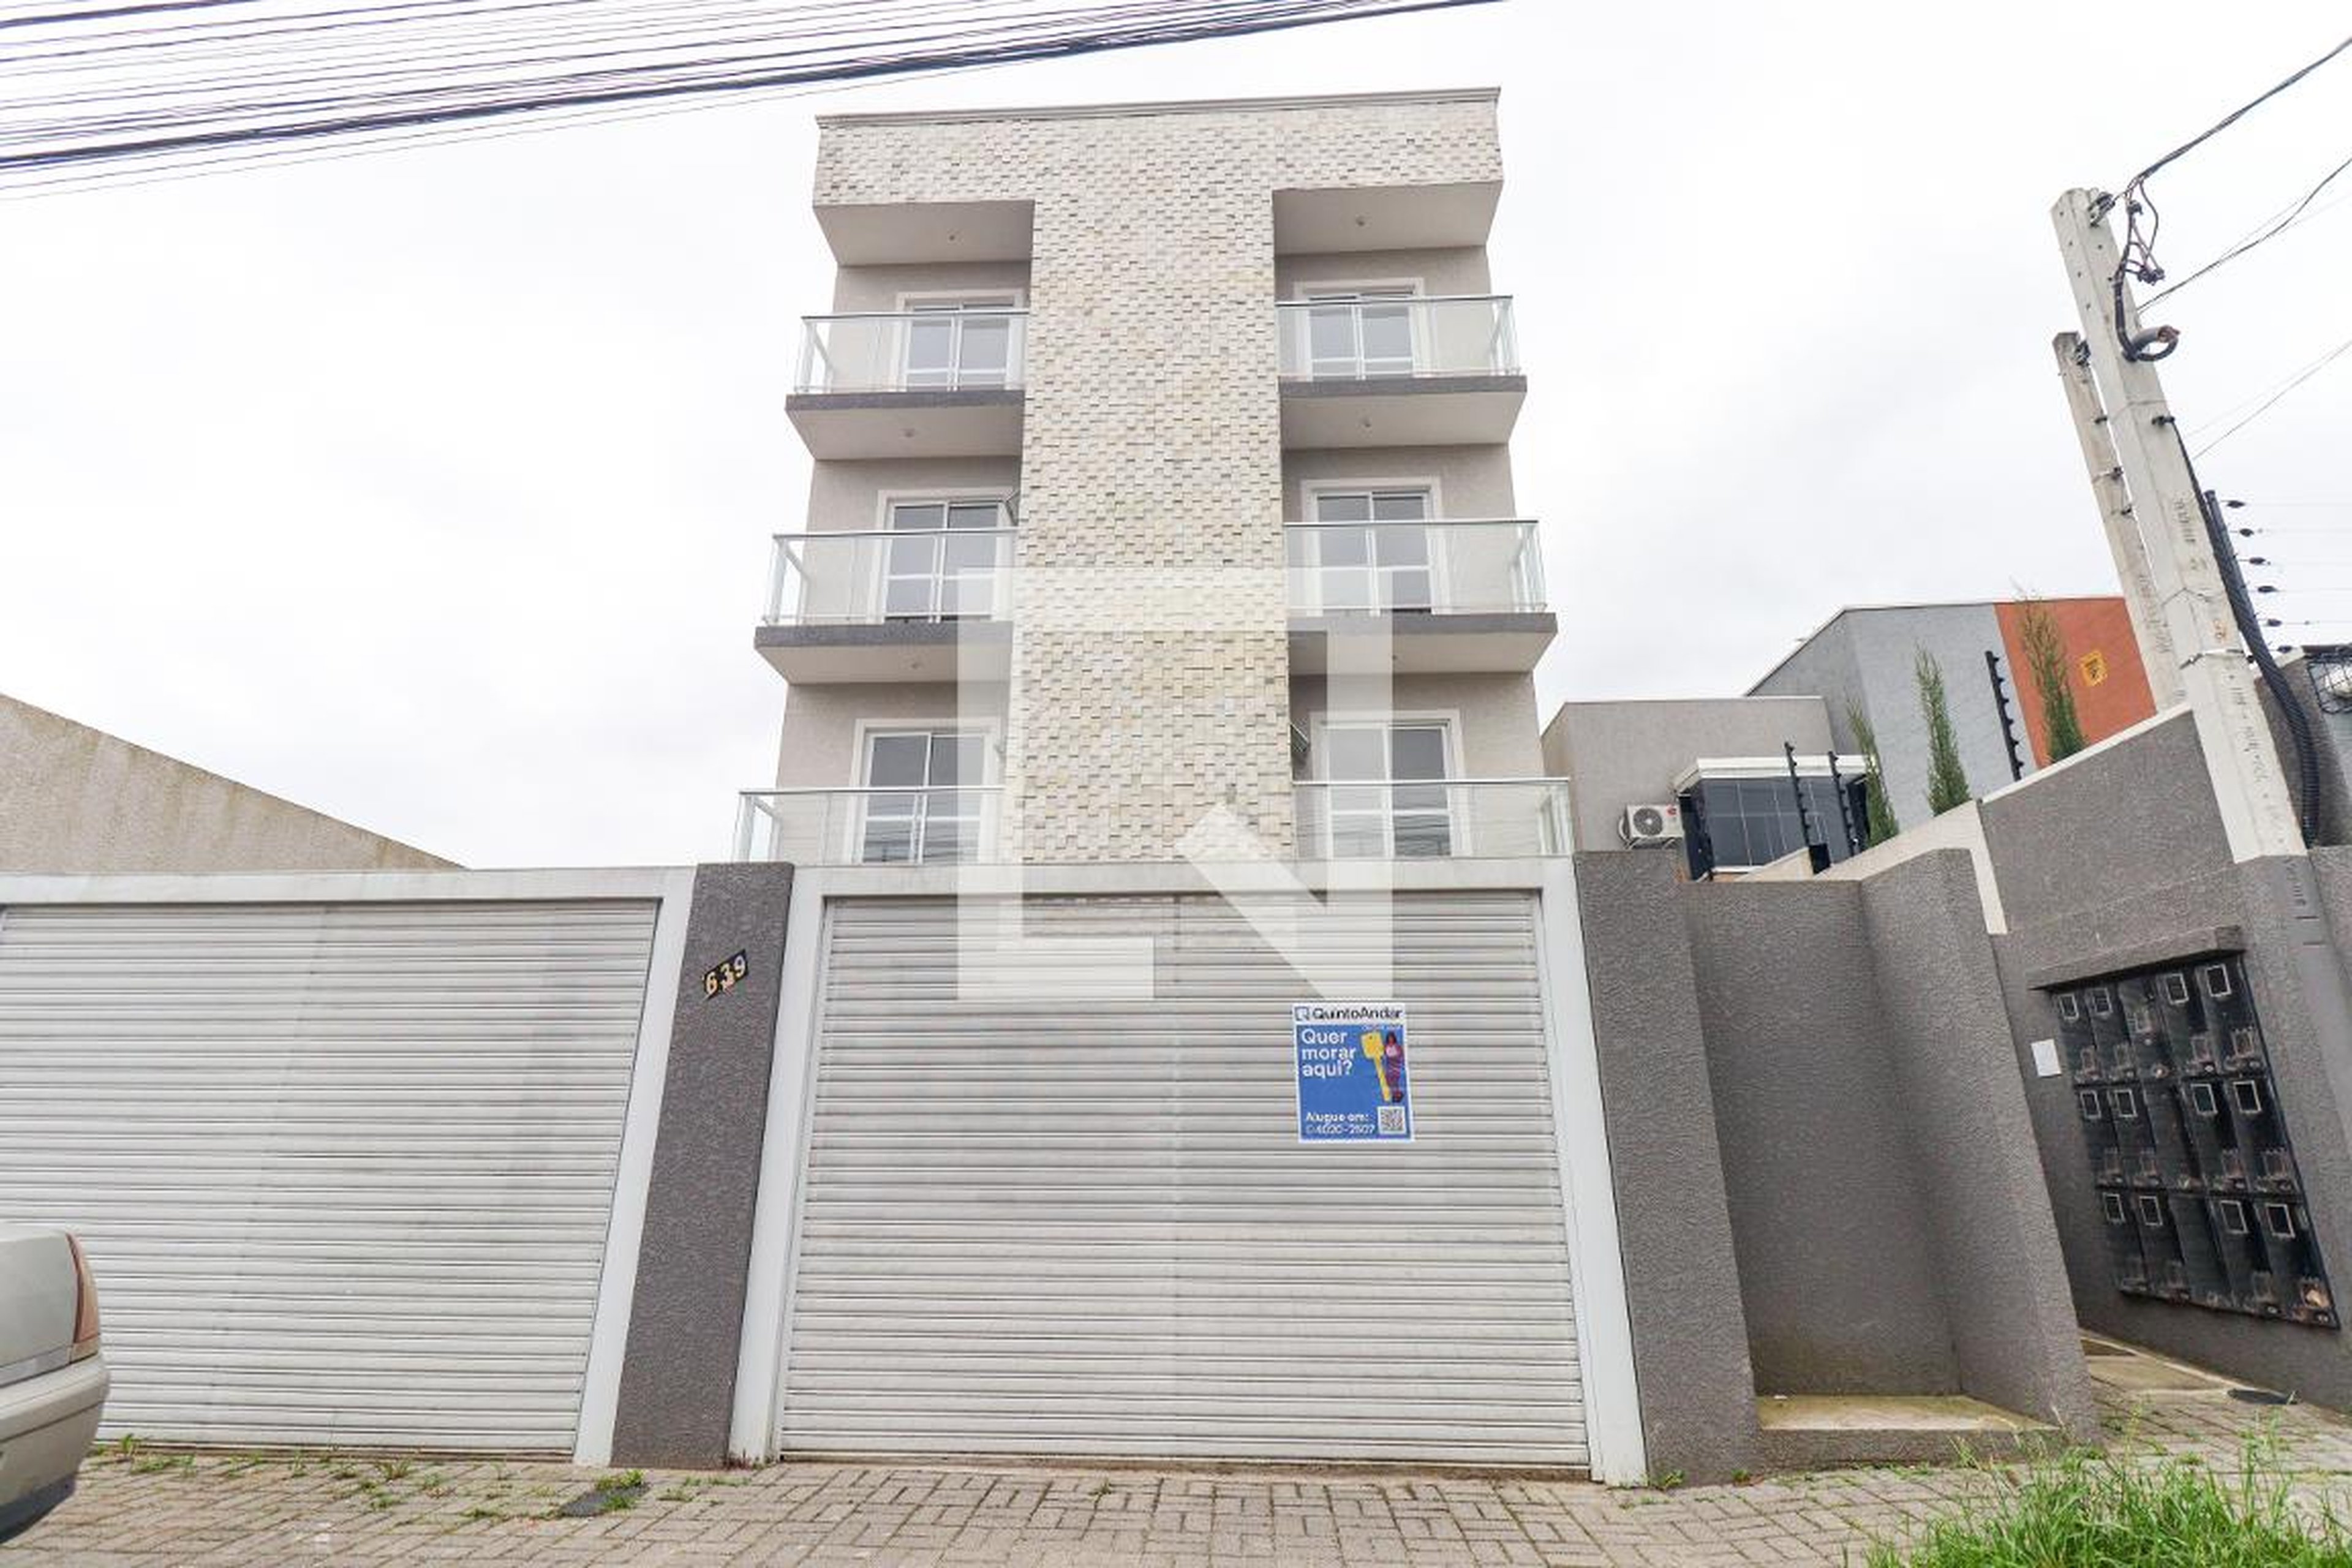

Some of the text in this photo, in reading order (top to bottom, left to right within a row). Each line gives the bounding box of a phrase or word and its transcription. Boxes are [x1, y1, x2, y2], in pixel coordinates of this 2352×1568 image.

[705, 954, 746, 995] 639
[1313, 1006, 1403, 1020] QuintoAndar
[1302, 1028, 1347, 1044] Quer
[1302, 1047, 1356, 1060] morar
[1302, 1059, 1352, 1079] aqui?
